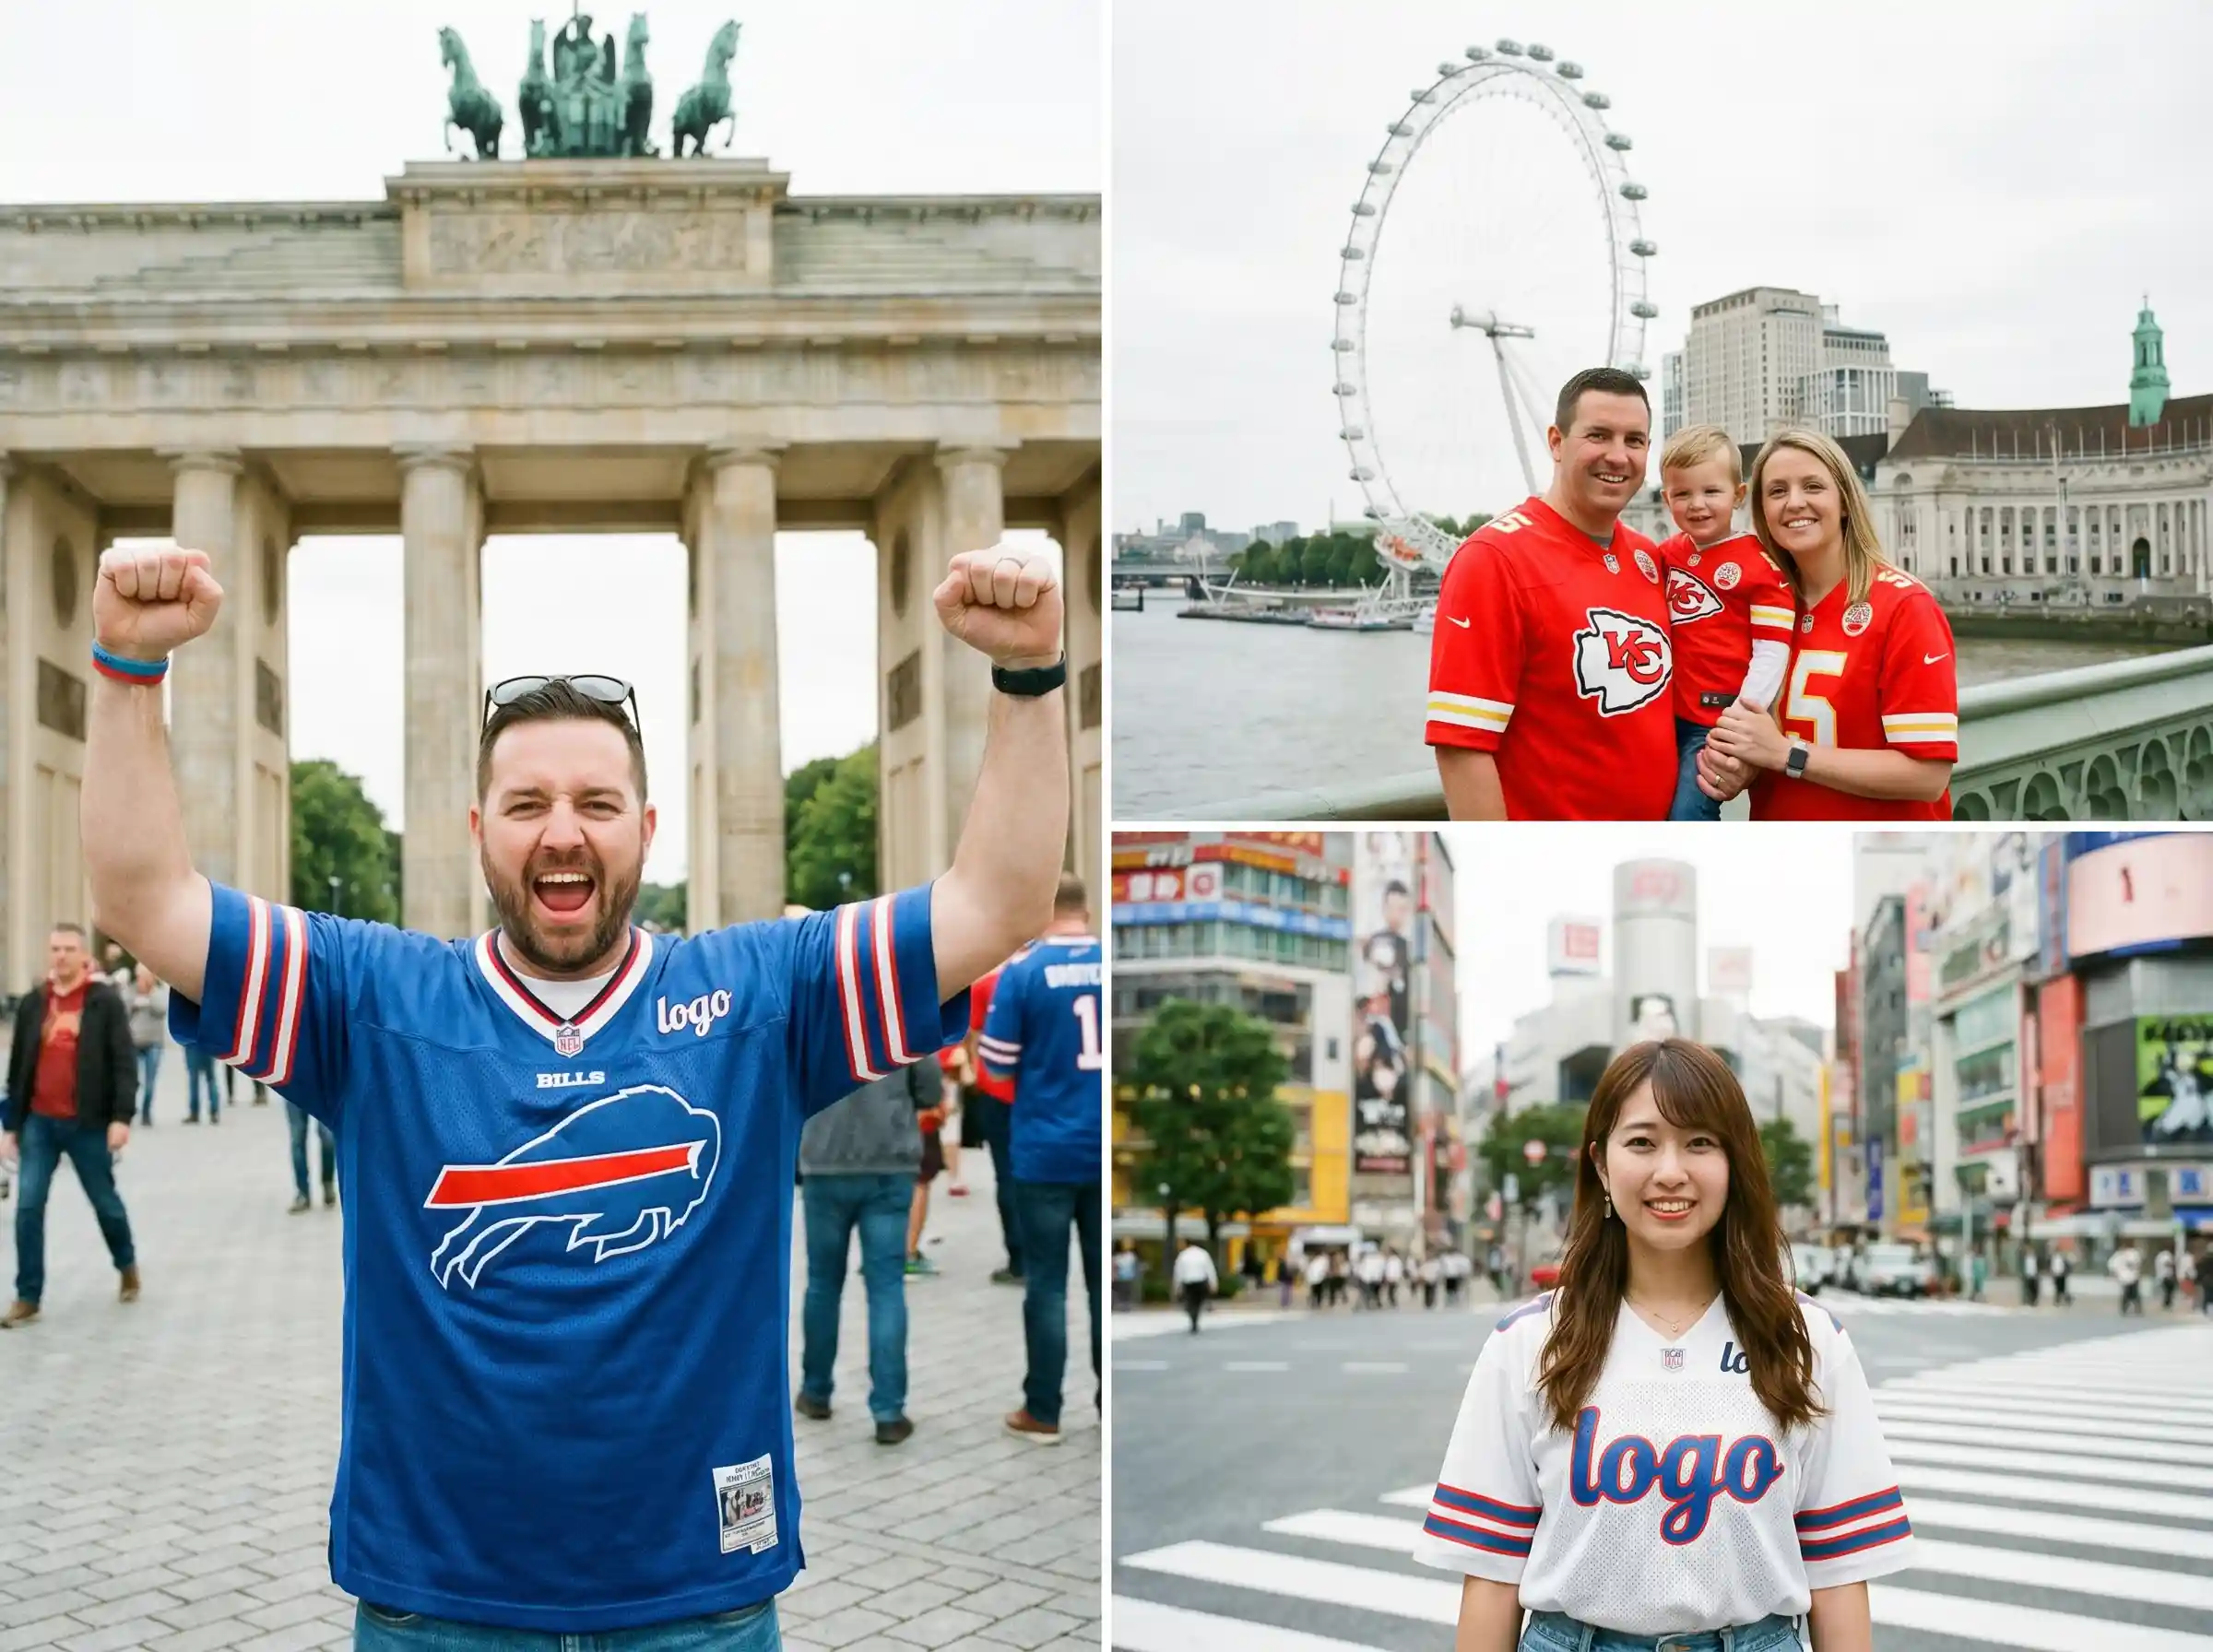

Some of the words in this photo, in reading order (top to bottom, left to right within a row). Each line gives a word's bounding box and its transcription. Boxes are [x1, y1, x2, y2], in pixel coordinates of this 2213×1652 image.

[1669, 580, 1705, 614] KC
[1603, 631, 1663, 684] KC
[1785, 649, 1848, 749] 5
[657, 988, 733, 1037] logo
[536, 1070, 606, 1089] BILLS
[1569, 1405, 1785, 1546] logo
